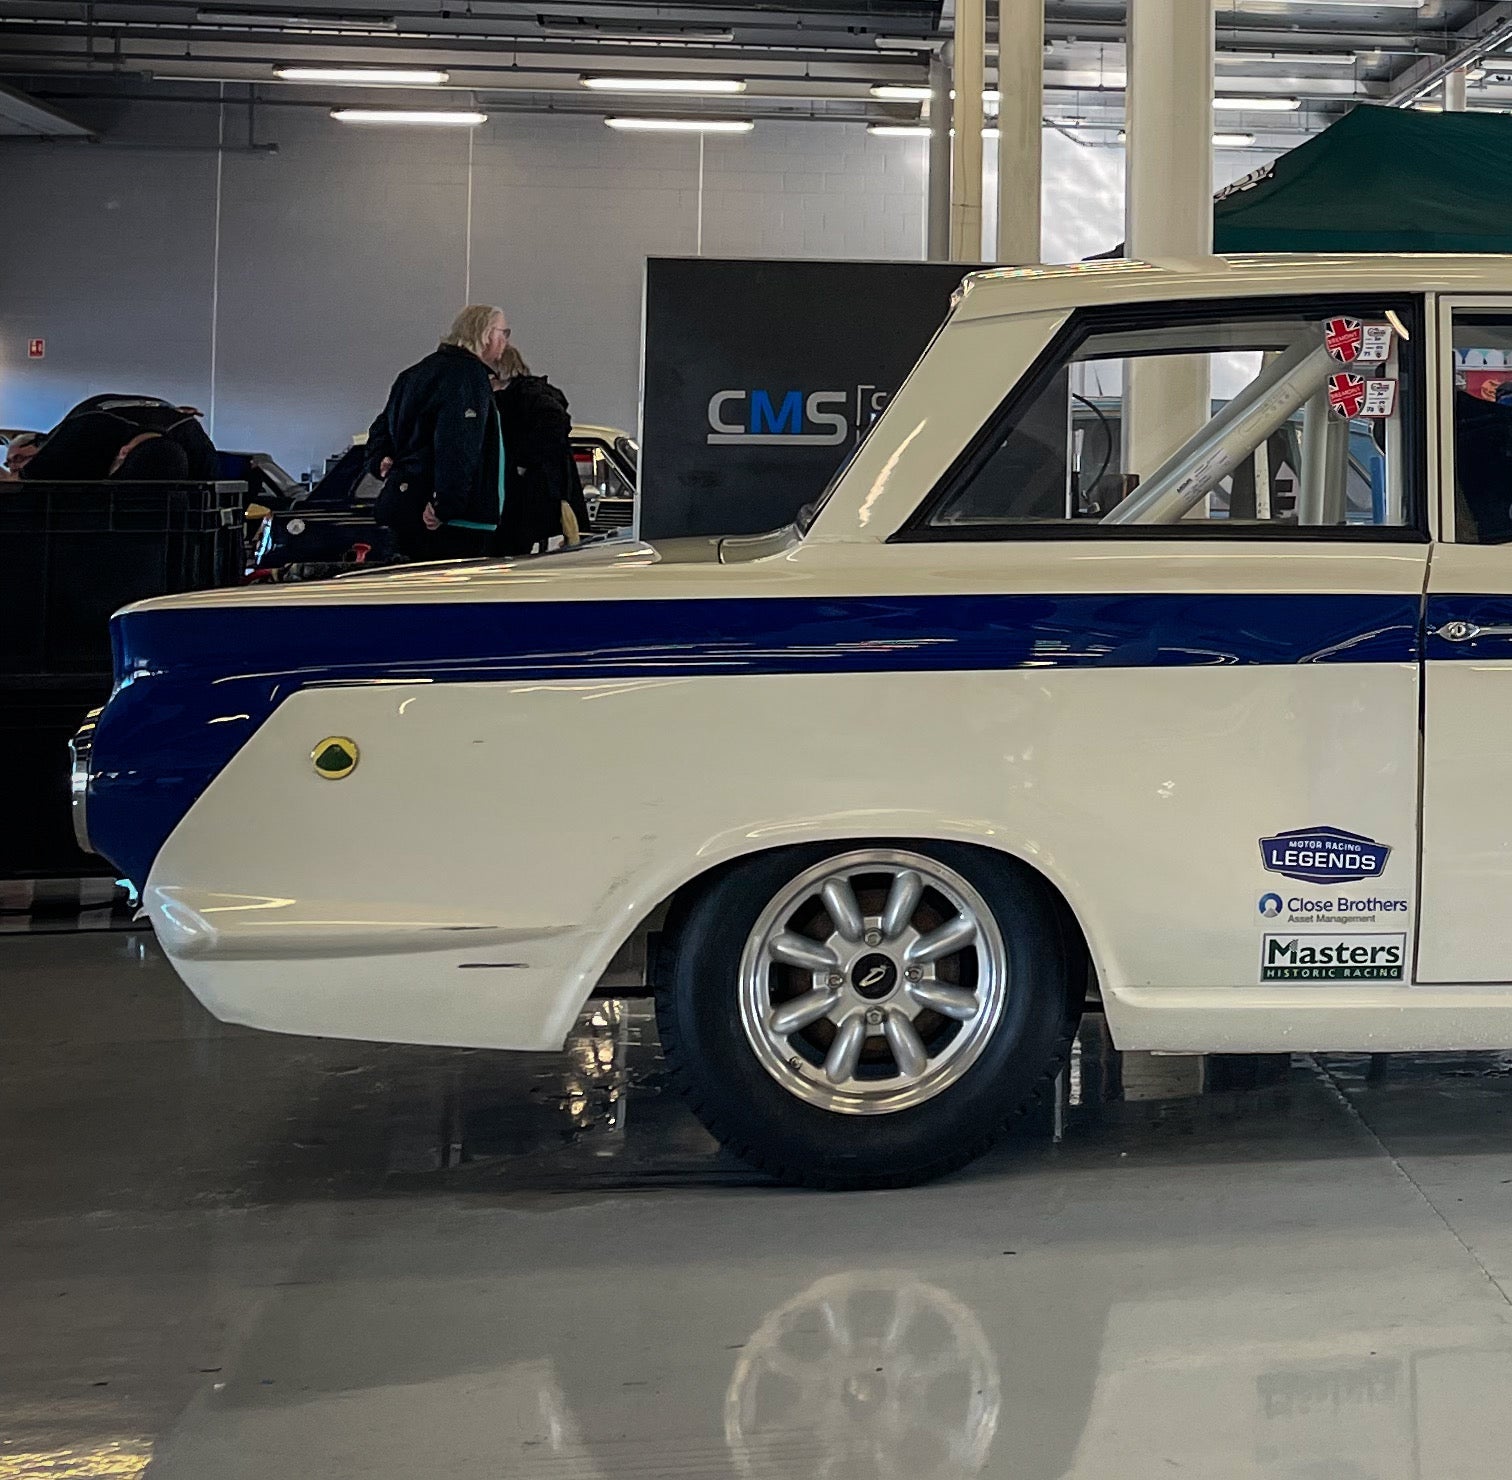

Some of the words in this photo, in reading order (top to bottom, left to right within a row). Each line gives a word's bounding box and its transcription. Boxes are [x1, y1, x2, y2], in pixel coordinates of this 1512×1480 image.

[707, 390, 848, 445] CMS
[1288, 840, 1322, 849] MOTOR
[1325, 841, 1362, 852] RACING
[1271, 849, 1376, 870] LEGENDS
[1287, 897, 1333, 912] Close
[1337, 897, 1408, 912] Brothers
[1287, 914, 1314, 923] Asset
[1316, 914, 1376, 924] Management
[1268, 938, 1400, 965] Masters
[1266, 968, 1337, 978] HISTORIC
[1344, 968, 1398, 977] RACING
